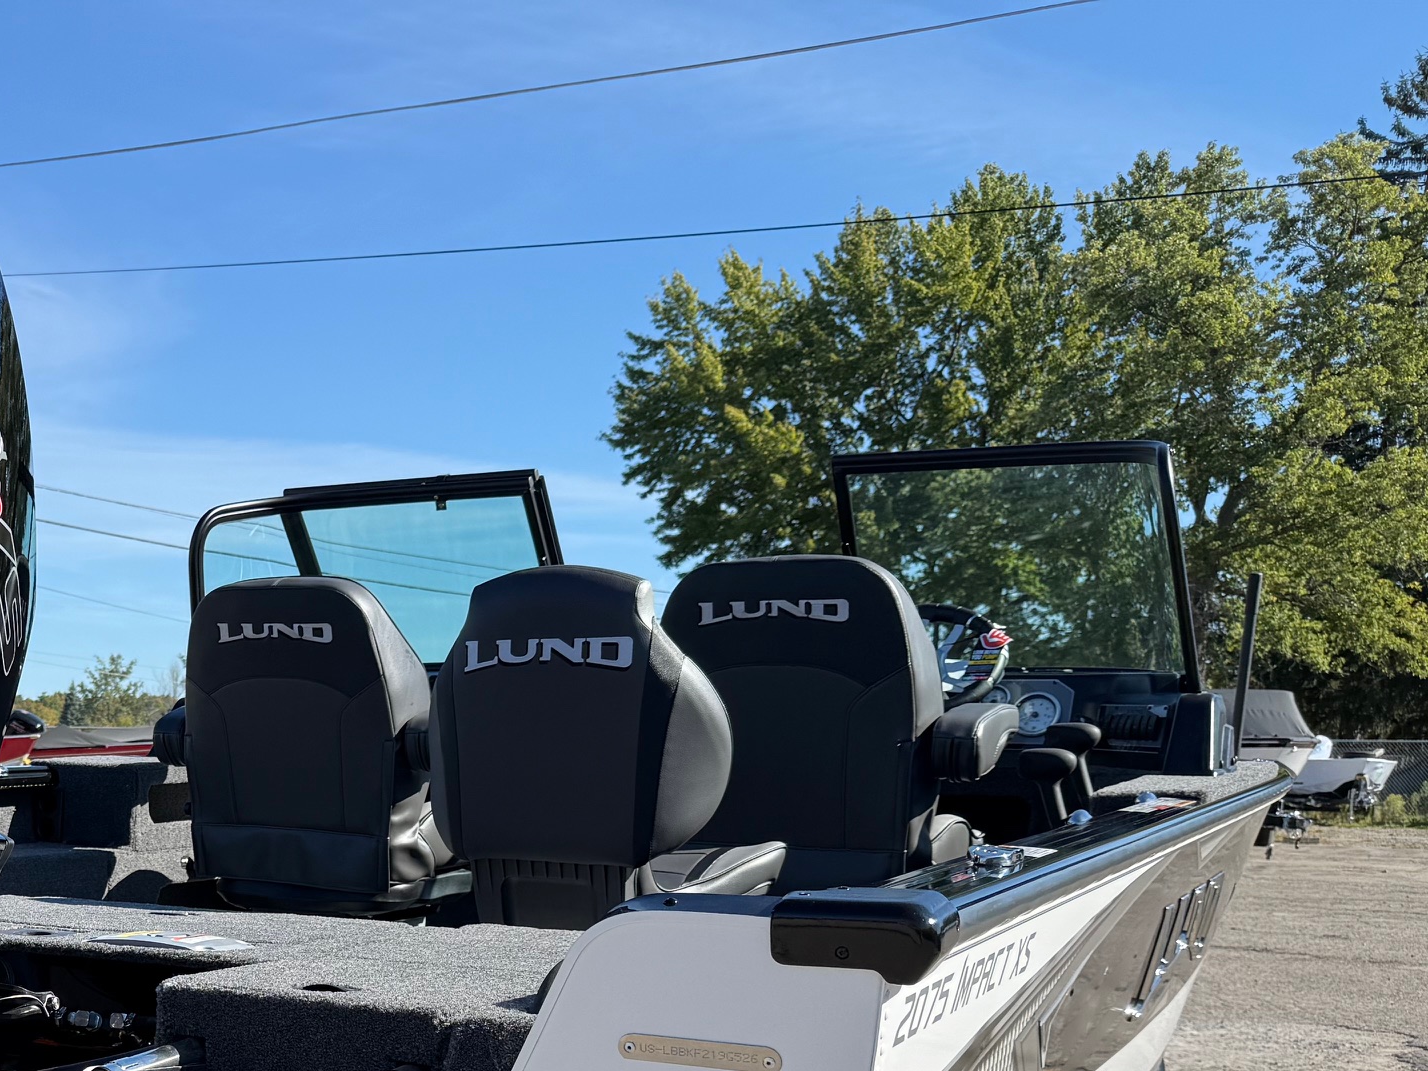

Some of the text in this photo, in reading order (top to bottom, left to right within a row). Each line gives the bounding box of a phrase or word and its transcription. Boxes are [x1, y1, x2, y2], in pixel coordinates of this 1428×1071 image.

[698, 599, 850, 626] LUND
[217, 623, 332, 643] LUND
[464, 636, 634, 673] LUND
[892, 932, 1037, 1048] 2075 IMPACT XS
